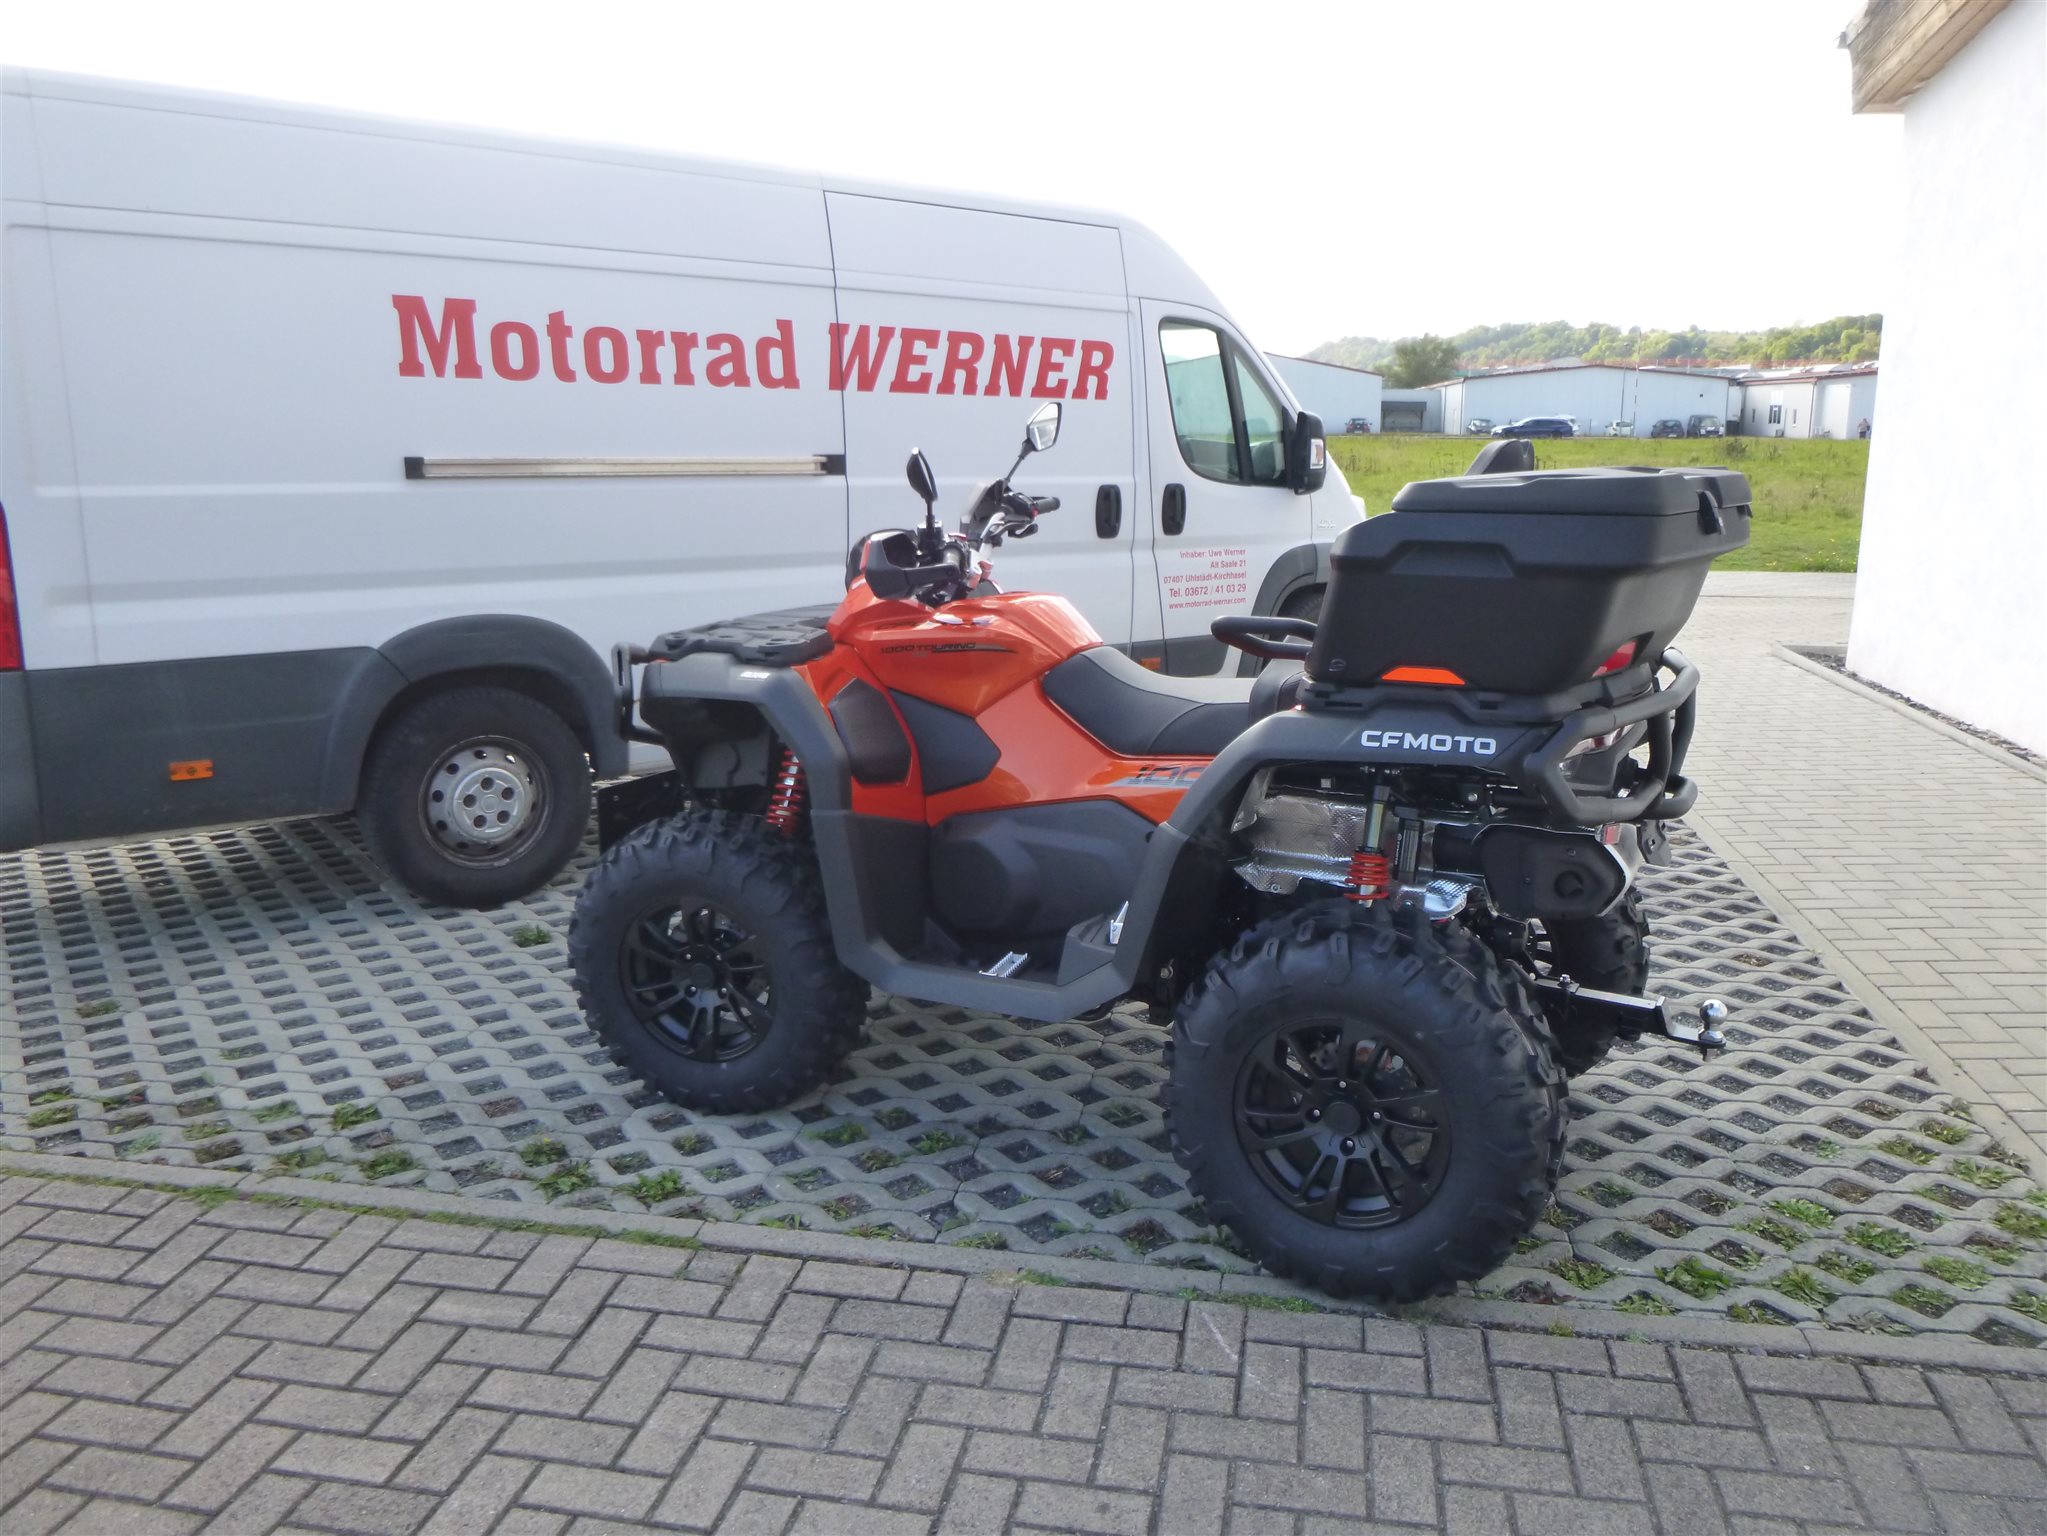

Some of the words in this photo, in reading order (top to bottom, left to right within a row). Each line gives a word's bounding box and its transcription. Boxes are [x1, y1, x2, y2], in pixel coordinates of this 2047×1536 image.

[391, 294, 801, 390] Motorrad
[827, 322, 1115, 401] WERNER
[1180, 550, 1206, 559] Inhaber:
[1208, 549, 1222, 558] Uwe
[1224, 548, 1246, 556] Werner
[1210, 561, 1219, 569] Alt
[1220, 560, 1238, 568] Saale
[1239, 559, 1247, 567] 21
[1163, 575, 1184, 584] 07407
[1185, 571, 1247, 583] Uhlstädt-Kirchhasel
[1169, 588, 1183, 598] Tel.
[1185, 586, 1209, 597] 03672
[1215, 585, 1224, 594] 41
[1226, 584, 1236, 593] 03
[1237, 583, 1247, 592] 29
[1169, 597, 1247, 609] www.motorrad-werner.com
[1360, 730, 1497, 755] CFMOTO
